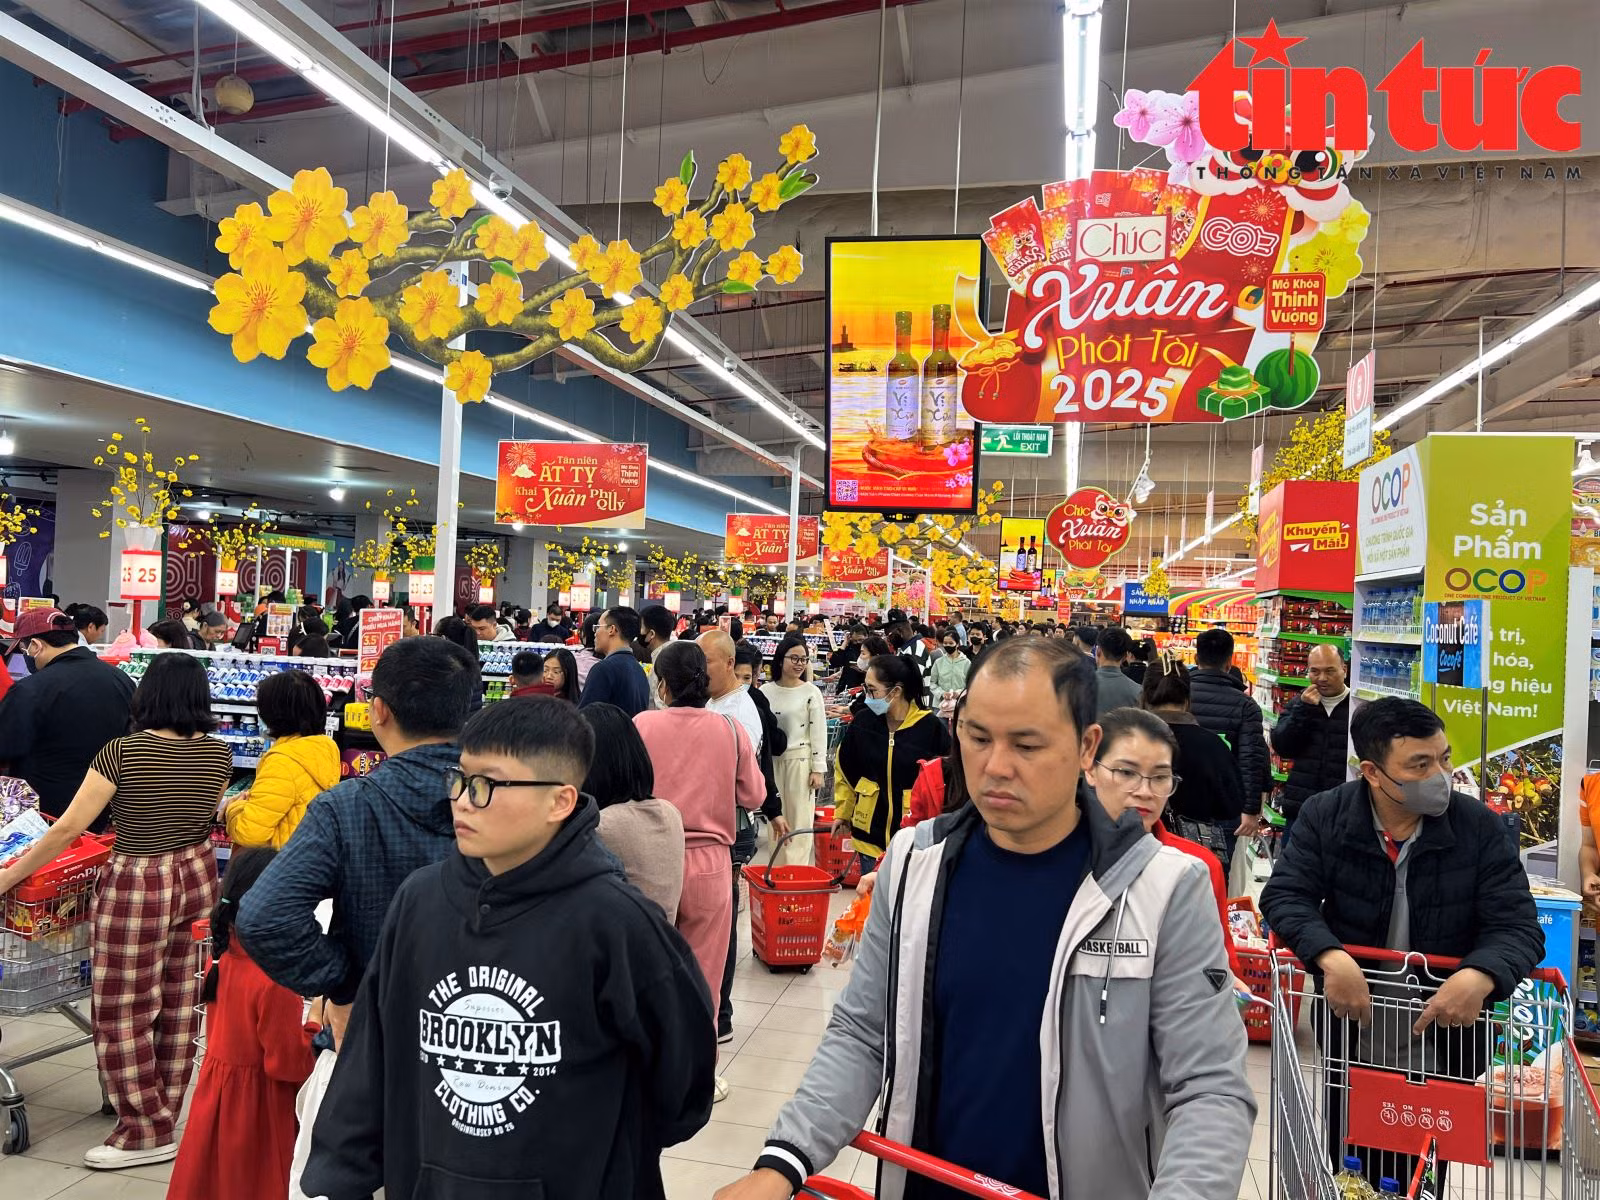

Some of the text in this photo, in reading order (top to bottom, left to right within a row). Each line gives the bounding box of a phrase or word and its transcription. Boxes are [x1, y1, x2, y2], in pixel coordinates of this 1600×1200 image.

[1079, 222, 1162, 258] Chúc
[1200, 216, 1280, 257] GO!
[1024, 262, 1229, 349] Xuân
[1271, 291, 1319, 311] Thịnh
[1057, 330, 1199, 369] Phát Tài
[1050, 368, 1175, 417] 2025
[1020, 443, 1041, 451] EXIT
[515, 486, 538, 496] Khai
[525, 487, 587, 513] Xuân
[1371, 463, 1411, 514] OCOP
[1470, 499, 1527, 527] Sản
[1286, 522, 1337, 537] Khuyến
[744, 541, 783, 557] Xuân
[1453, 528, 1541, 560] Phẩm
[137, 567, 157, 583] 25
[1444, 567, 1549, 595] OCOP
[1425, 616, 1458, 645] Coconut
[1459, 613, 1479, 645] Café
[1499, 628, 1526, 645] trị,
[1493, 651, 1534, 671] hóa,
[1511, 677, 1552, 696] hiệu
[1443, 698, 1538, 718] Việt Nam!
[428, 965, 545, 1018] THE ORIGINAL
[420, 1008, 561, 1064] BROOKLYN
[533, 1065, 557, 1077] 2014
[434, 1079, 541, 1127] CLOTHING CO.
